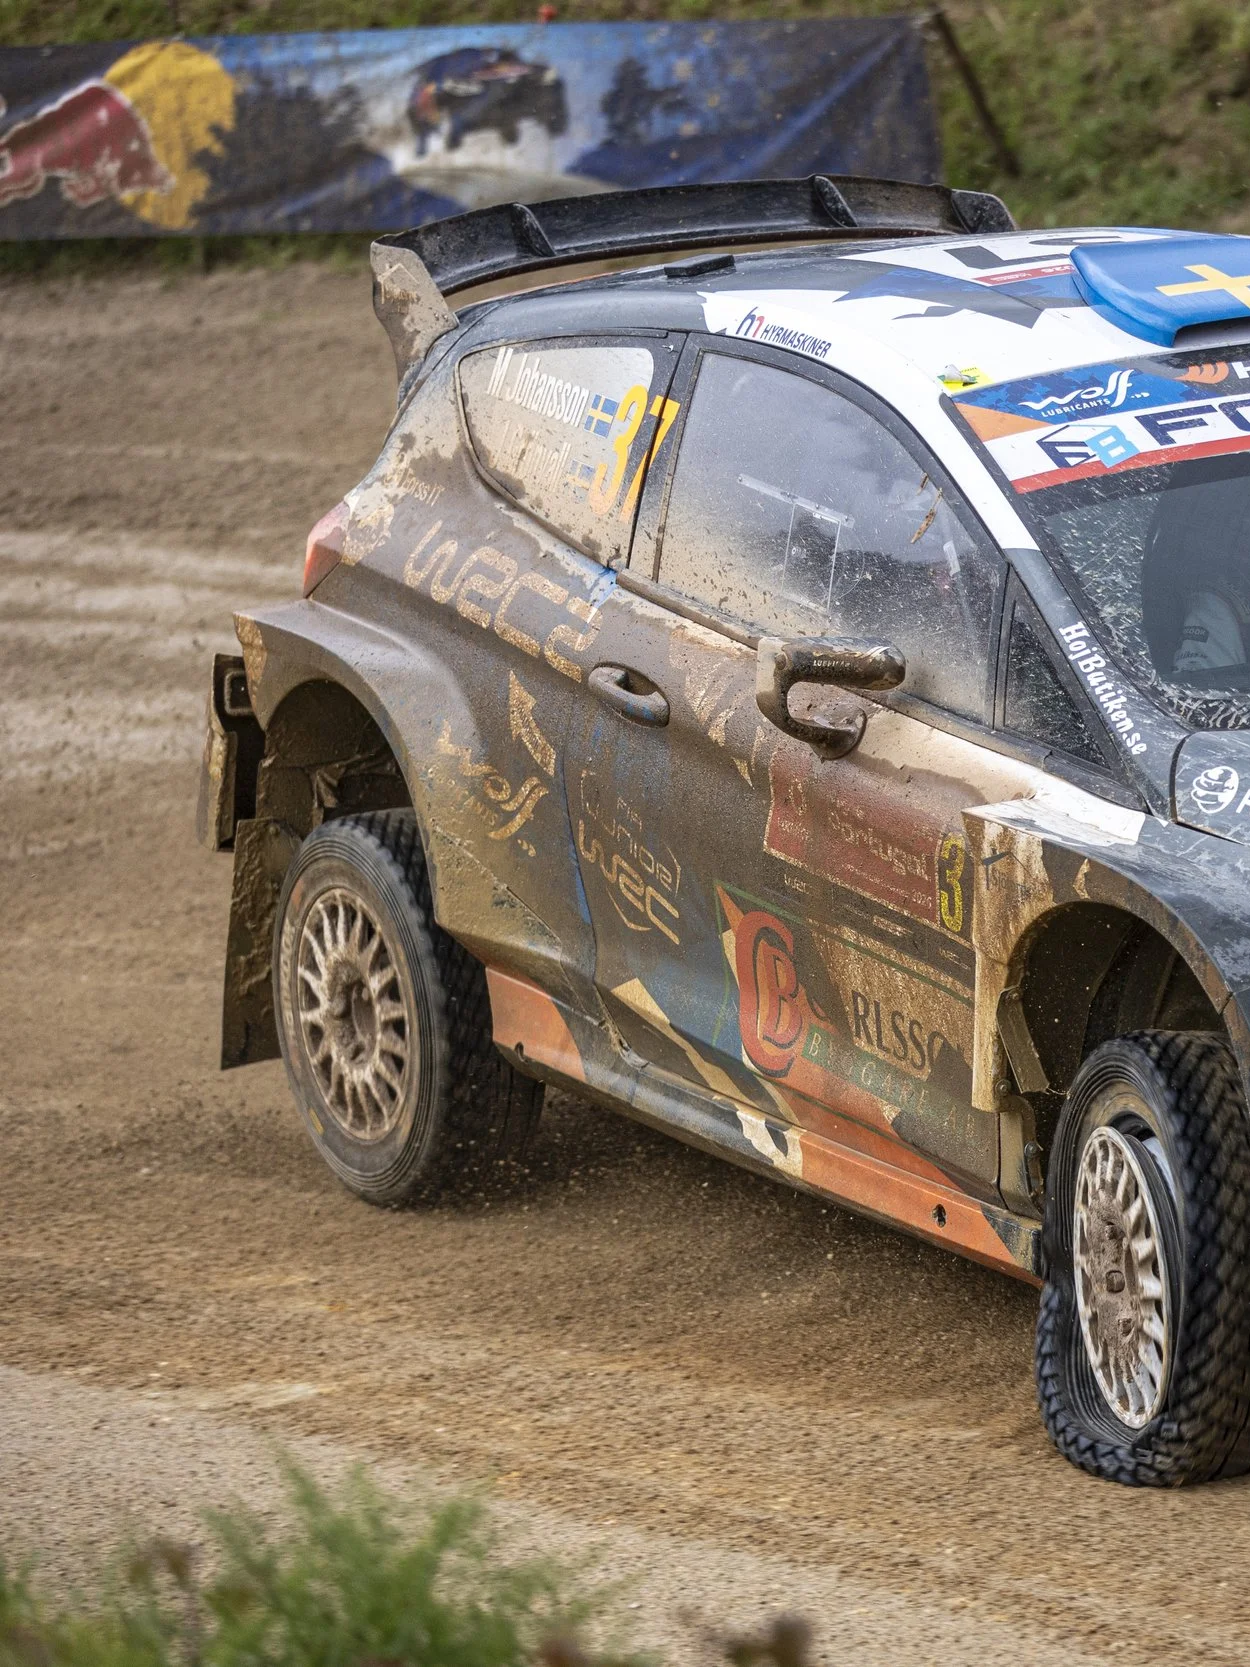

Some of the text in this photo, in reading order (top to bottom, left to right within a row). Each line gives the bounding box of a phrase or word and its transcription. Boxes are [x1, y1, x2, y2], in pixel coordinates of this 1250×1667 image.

[760, 323, 832, 358] HYRMASKINER
[486, 346, 590, 428] M Johansson
[1041, 398, 1111, 418] LUBRICANTS
[588, 383, 681, 525] 37
[1058, 621, 1148, 755] HojButiken.se
